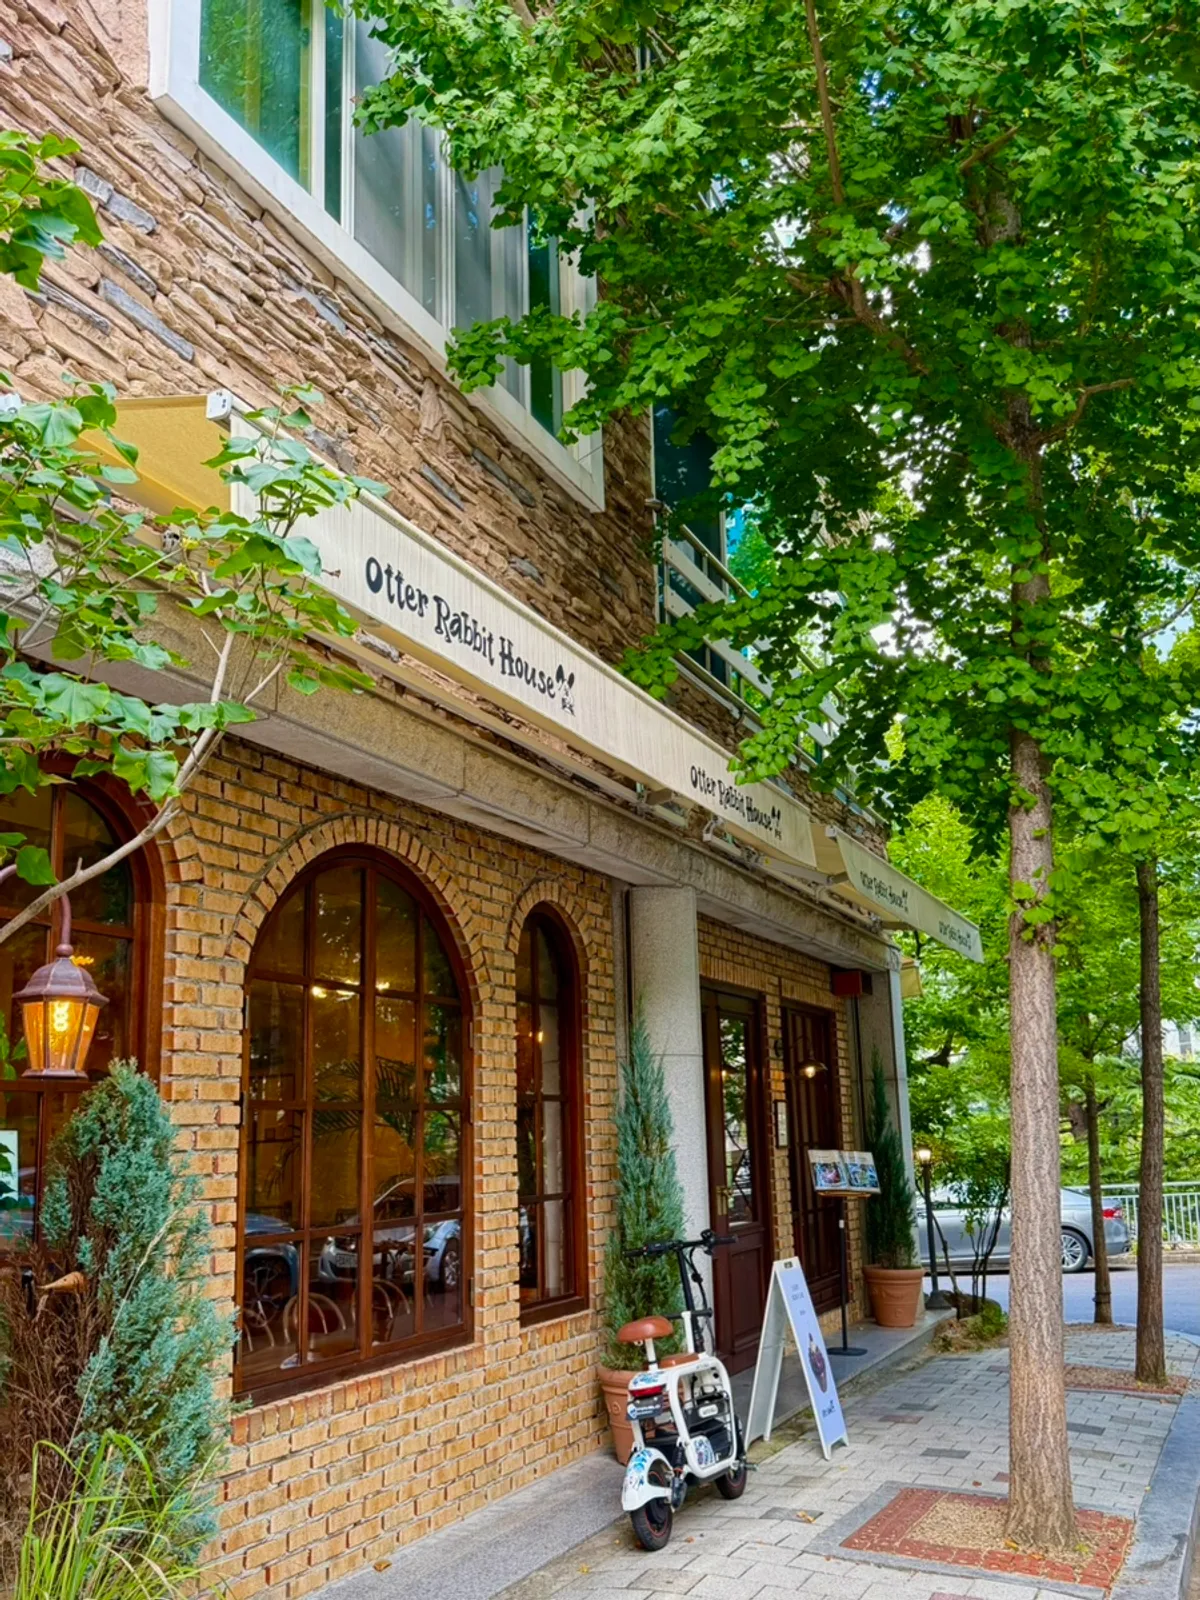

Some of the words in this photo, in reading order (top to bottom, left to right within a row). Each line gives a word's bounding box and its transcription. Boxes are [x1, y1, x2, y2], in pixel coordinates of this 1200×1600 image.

[366, 557, 428, 617] Otter
[433, 595, 495, 667] Rabbit
[499, 636, 556, 698] House
[690, 765, 716, 797] Otter
